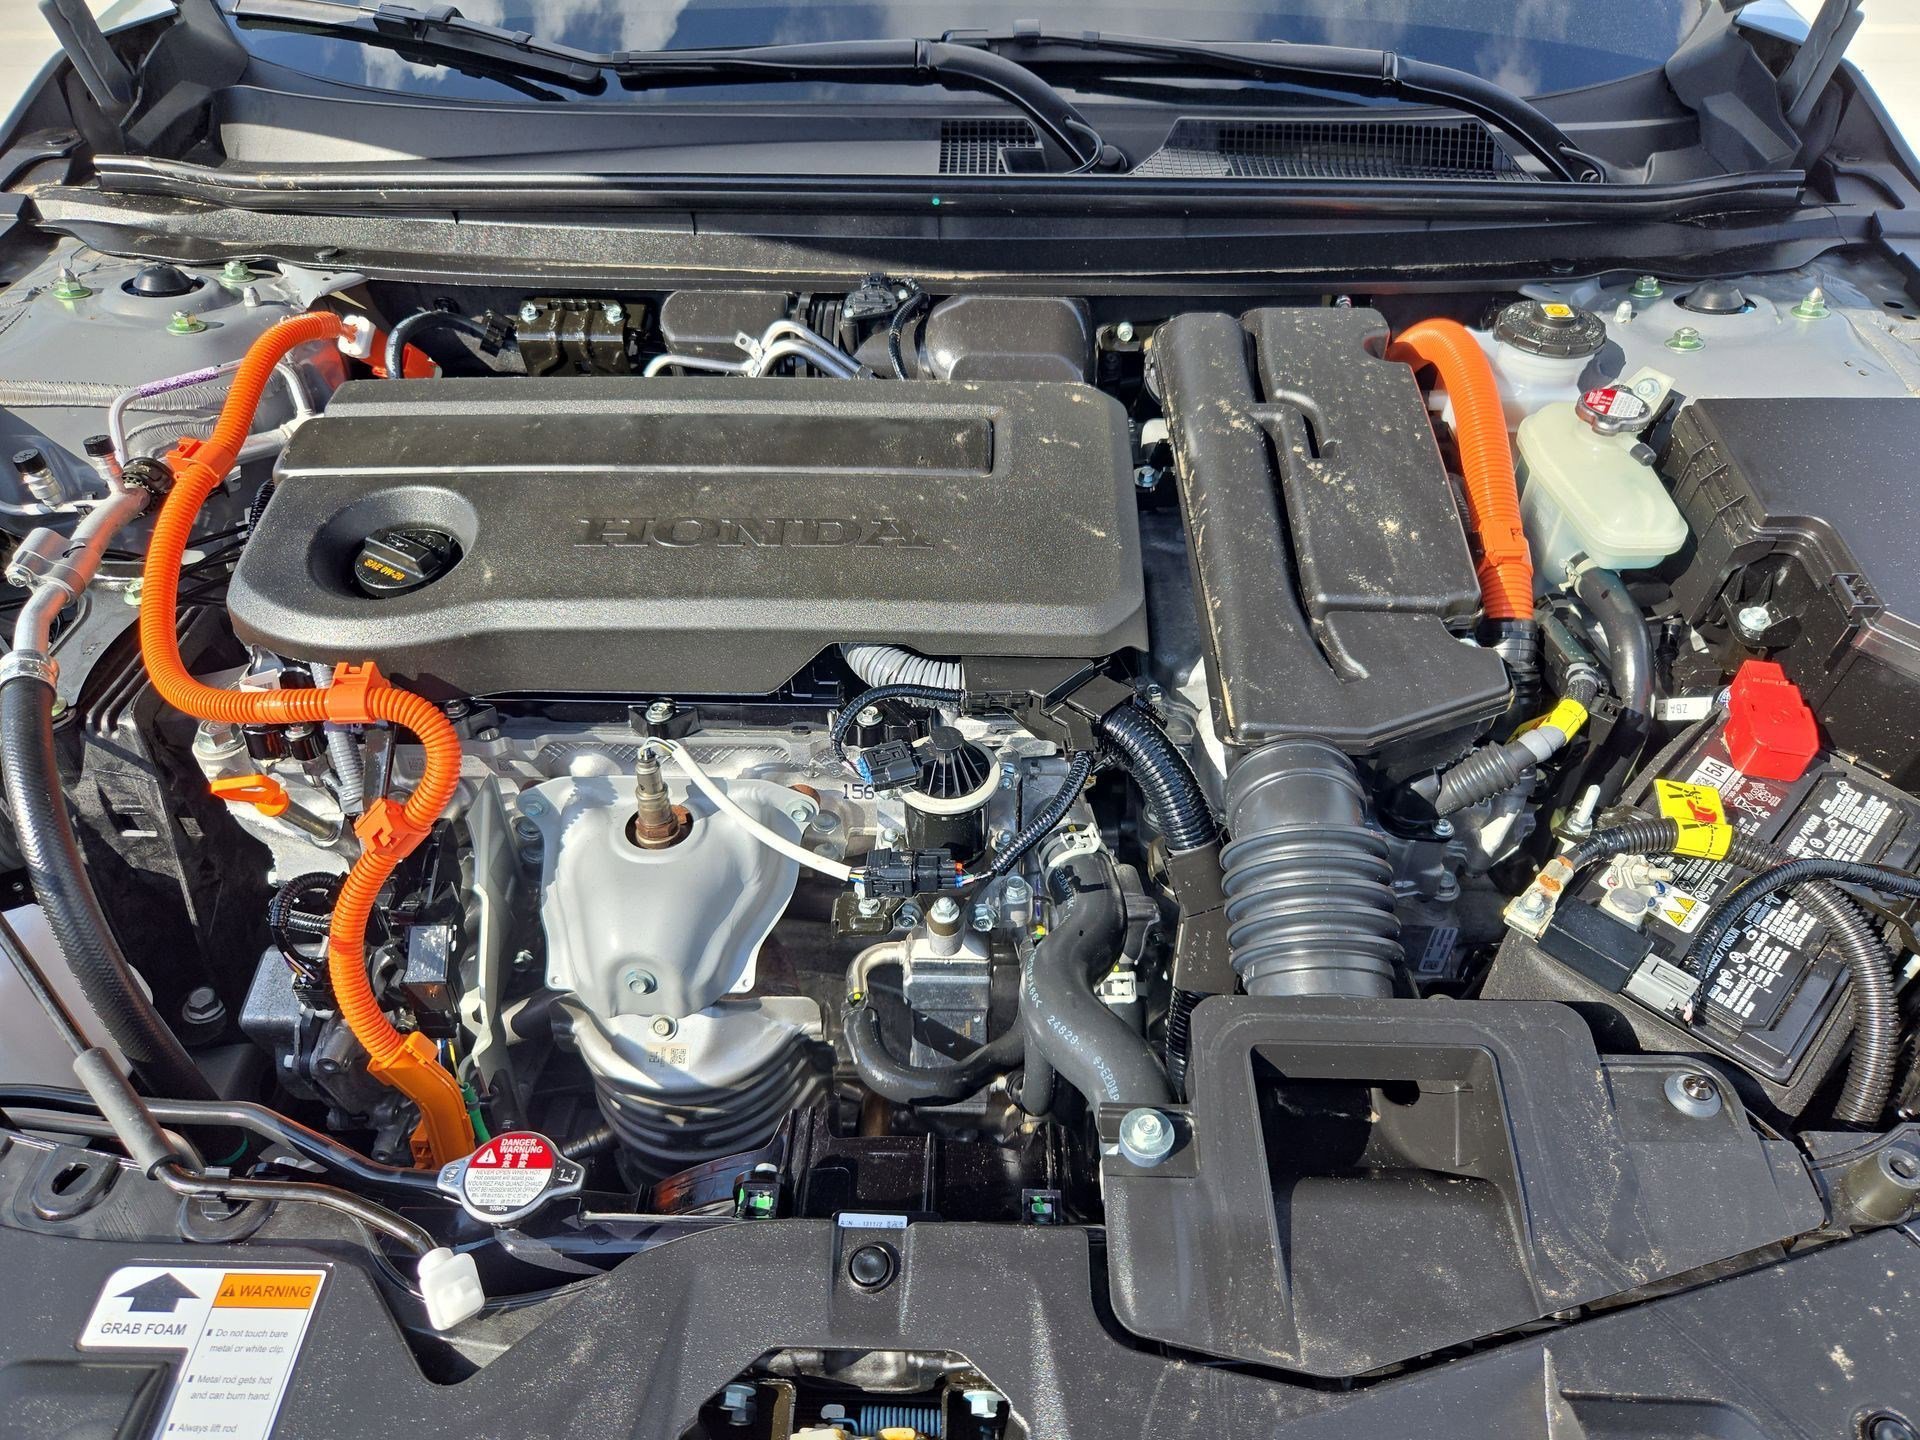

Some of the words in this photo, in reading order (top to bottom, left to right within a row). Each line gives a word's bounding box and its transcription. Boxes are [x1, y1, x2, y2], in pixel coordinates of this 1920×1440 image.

[573, 517, 936, 550] HONDA
[364, 558, 384, 572] SAE
[380, 566, 406, 581] 0W-20
[843, 783, 875, 800] 156
[501, 1138, 538, 1146] DANGER
[500, 1145, 543, 1154] WARNUNG
[560, 1168, 577, 1182] 1.1
[239, 1285, 312, 1298] WARNING
[101, 1323, 142, 1335] GRAB
[144, 1323, 187, 1336] FOAM
[215, 1329, 227, 1337] Do
[229, 1329, 243, 1338] not
[244, 1329, 268, 1338] touch
[269, 1329, 289, 1338] bare
[209, 1344, 233, 1353] metal
[245, 1344, 267, 1353] white
[269, 1345, 285, 1355] clip.
[197, 1375, 221, 1384] Metal
[222, 1375, 237, 1384] rod
[237, 1376, 257, 1386] gets
[257, 1376, 273, 1384] hot
[190, 1391, 206, 1400] and
[207, 1392, 225, 1400] can
[226, 1391, 247, 1400] burn
[248, 1392, 271, 1401] hand.
[177, 1423, 209, 1434] Always
[210, 1423, 222, 1433] lift
[222, 1423, 238, 1433] rod
